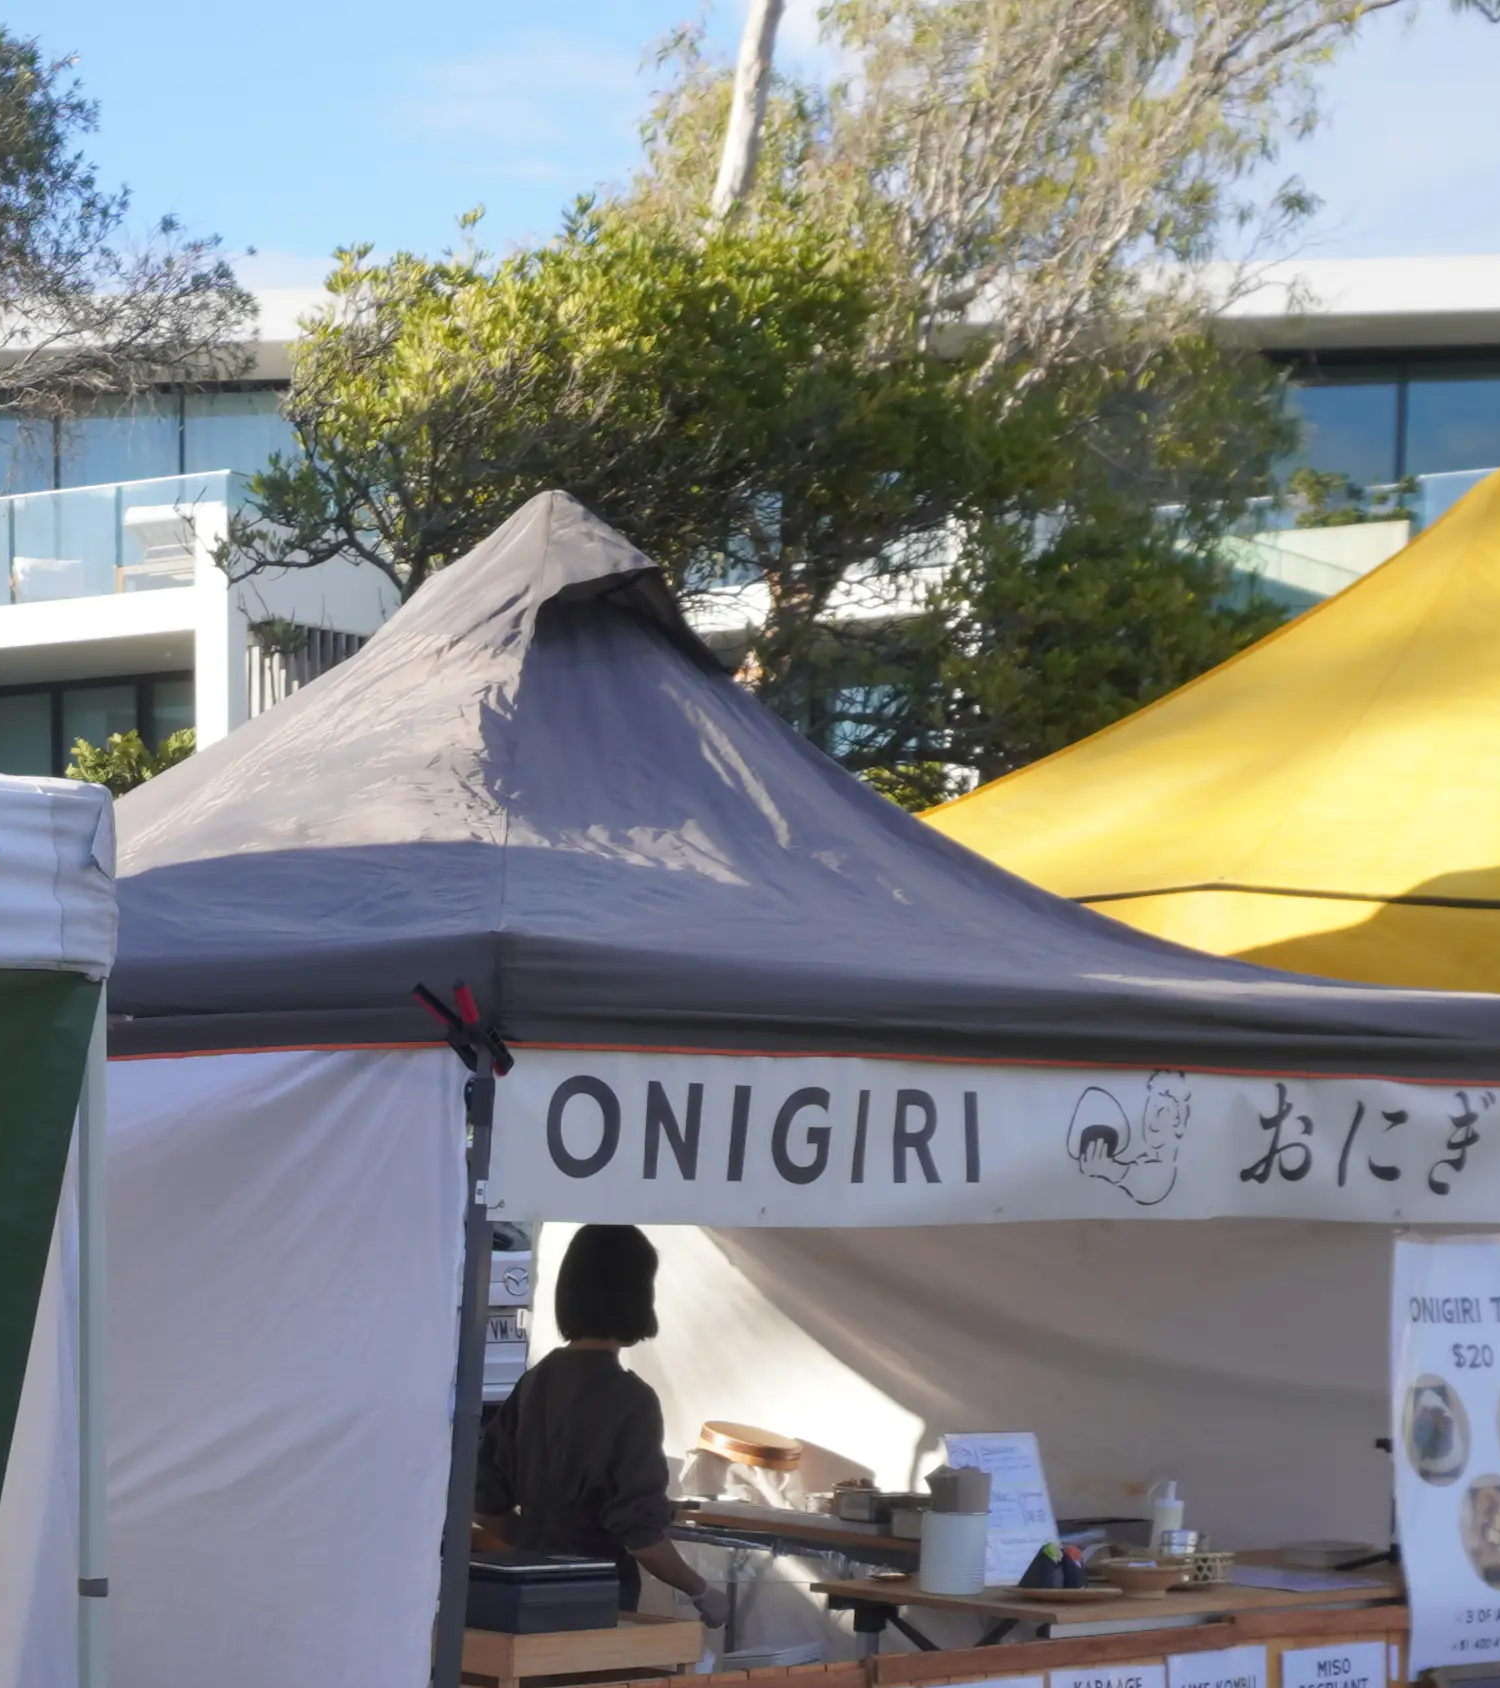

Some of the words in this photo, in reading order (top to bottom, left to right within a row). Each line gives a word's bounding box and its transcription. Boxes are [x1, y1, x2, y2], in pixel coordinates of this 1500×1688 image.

[546, 1074, 981, 1185] ONIGIRI
[1411, 1297, 1483, 1325] ONIGIRI
[1452, 1344, 1494, 1369] $20
[1466, 1610, 1474, 1624] 3
[1478, 1608, 1492, 1623] OF
[1317, 1658, 1351, 1678] MISO
